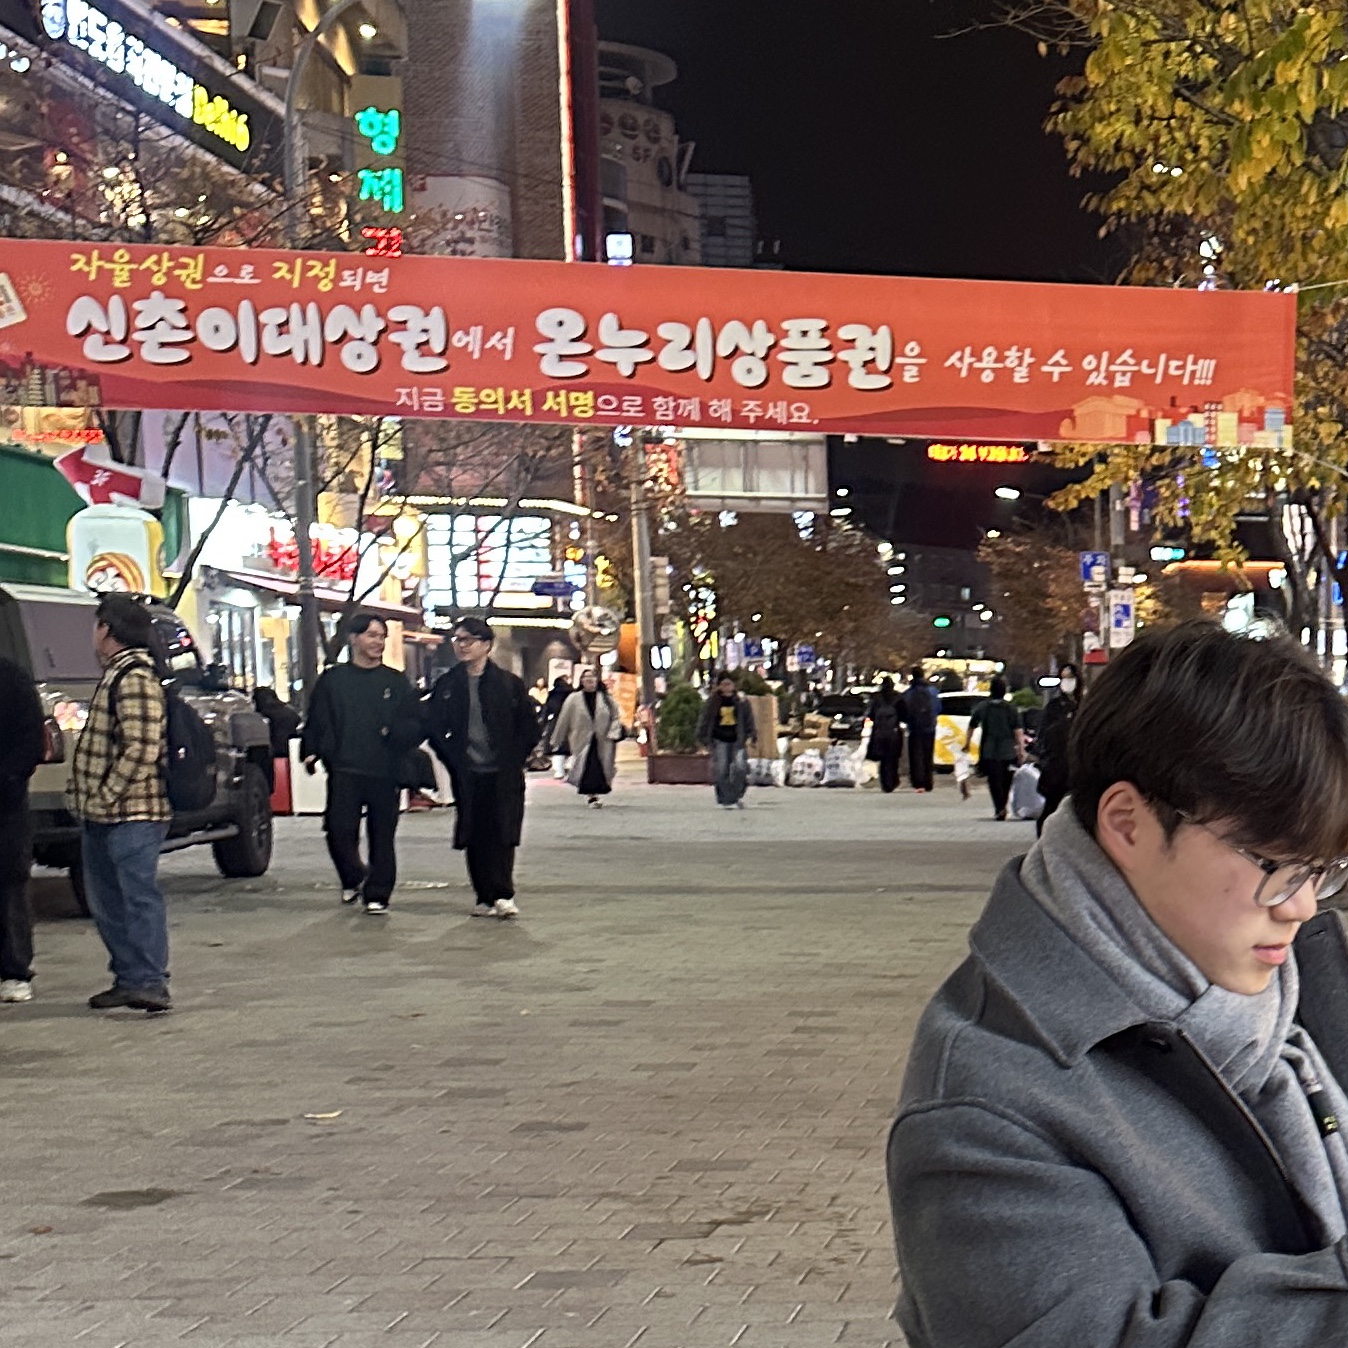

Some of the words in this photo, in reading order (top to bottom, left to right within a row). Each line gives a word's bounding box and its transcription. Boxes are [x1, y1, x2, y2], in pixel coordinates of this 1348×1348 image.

[70, 248, 261, 290] 자율상권으로
[271, 257, 390, 293] 지정되면
[65, 291, 515, 375] 신촌이대상권에서
[532, 306, 928, 391] 온누리상품권을
[943, 344, 1036, 384] 사용할
[1041, 348, 1073, 383] 수
[395, 385, 446, 412] 지금
[451, 385, 534, 416] 동의서
[541, 388, 646, 418] 서명으로
[651, 395, 700, 422] 함께
[708, 397, 732, 423] 해
[739, 399, 820, 425] 주세요.
